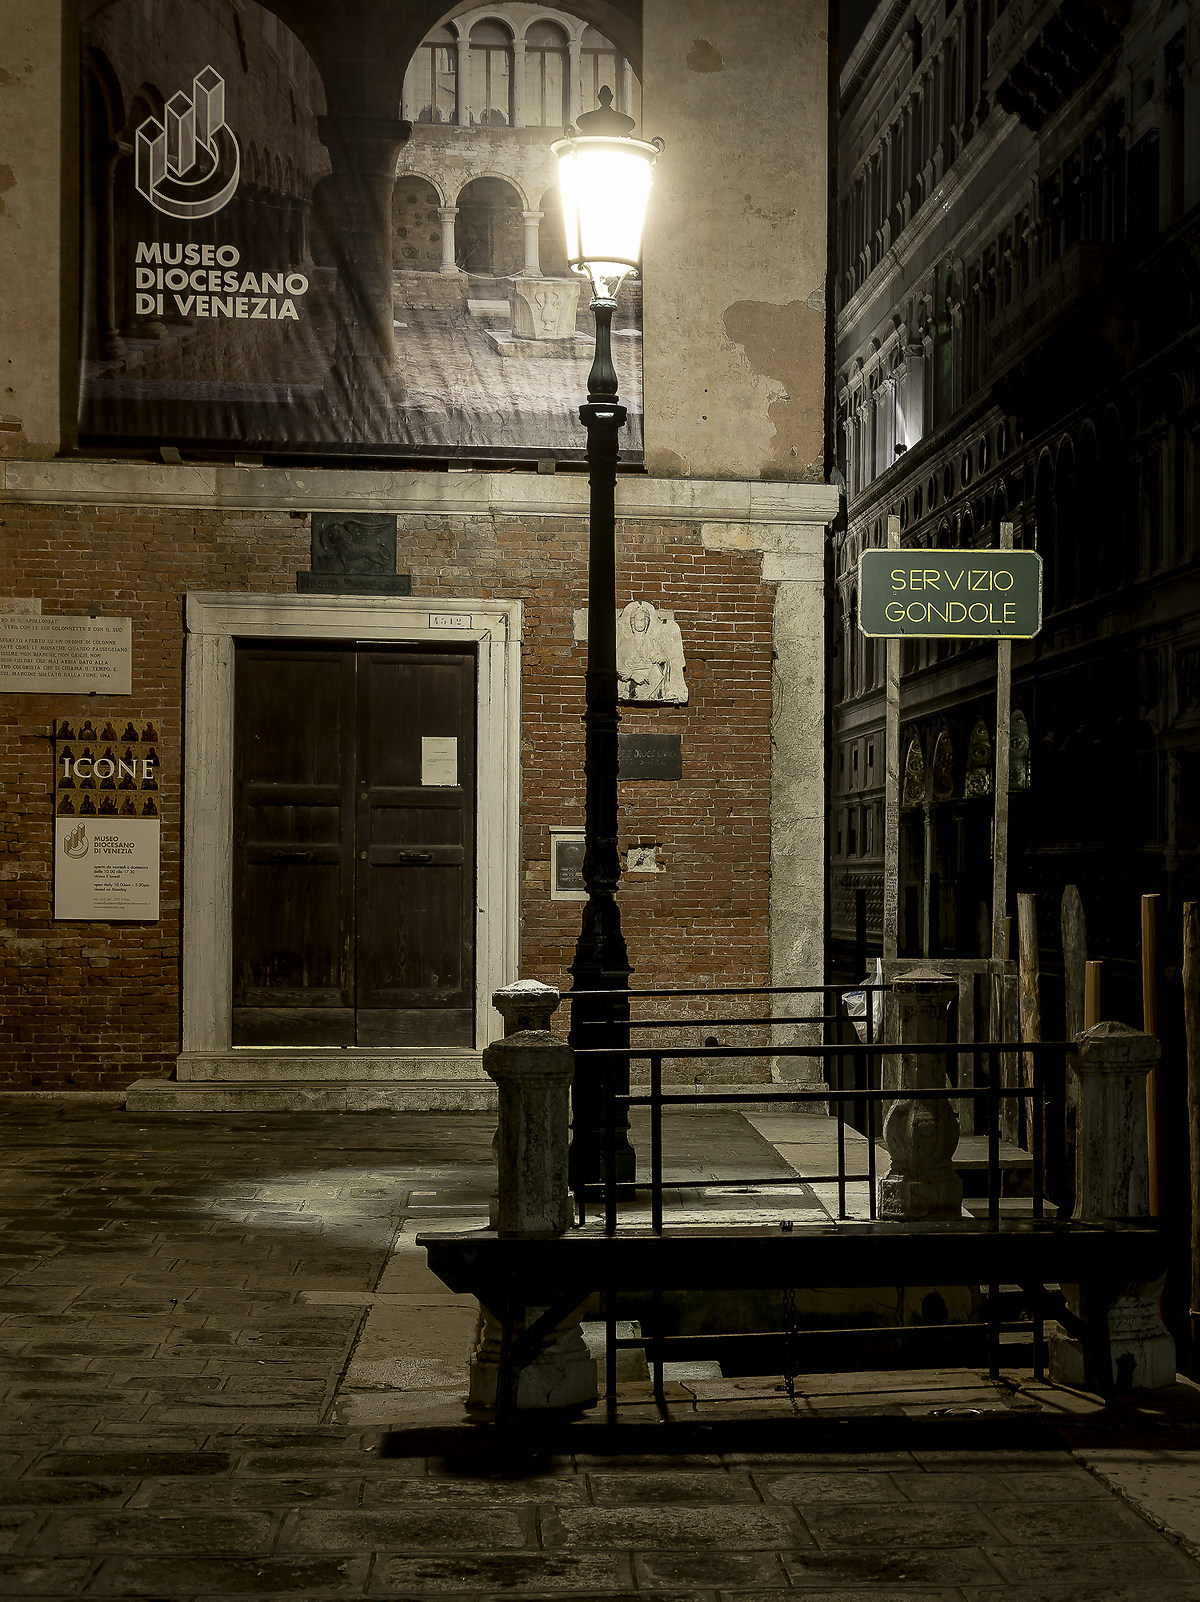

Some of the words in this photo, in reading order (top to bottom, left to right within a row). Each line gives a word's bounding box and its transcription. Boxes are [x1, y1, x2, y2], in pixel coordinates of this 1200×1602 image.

[134, 241, 240, 268] MUSEO
[135, 267, 309, 296] DIOCESANO
[135, 292, 164, 315] DI
[173, 294, 300, 321] VENEZIA
[890, 569, 1014, 591] SERVIZIO
[885, 601, 1016, 623] GONDOLE
[62, 757, 154, 780] ICONE
